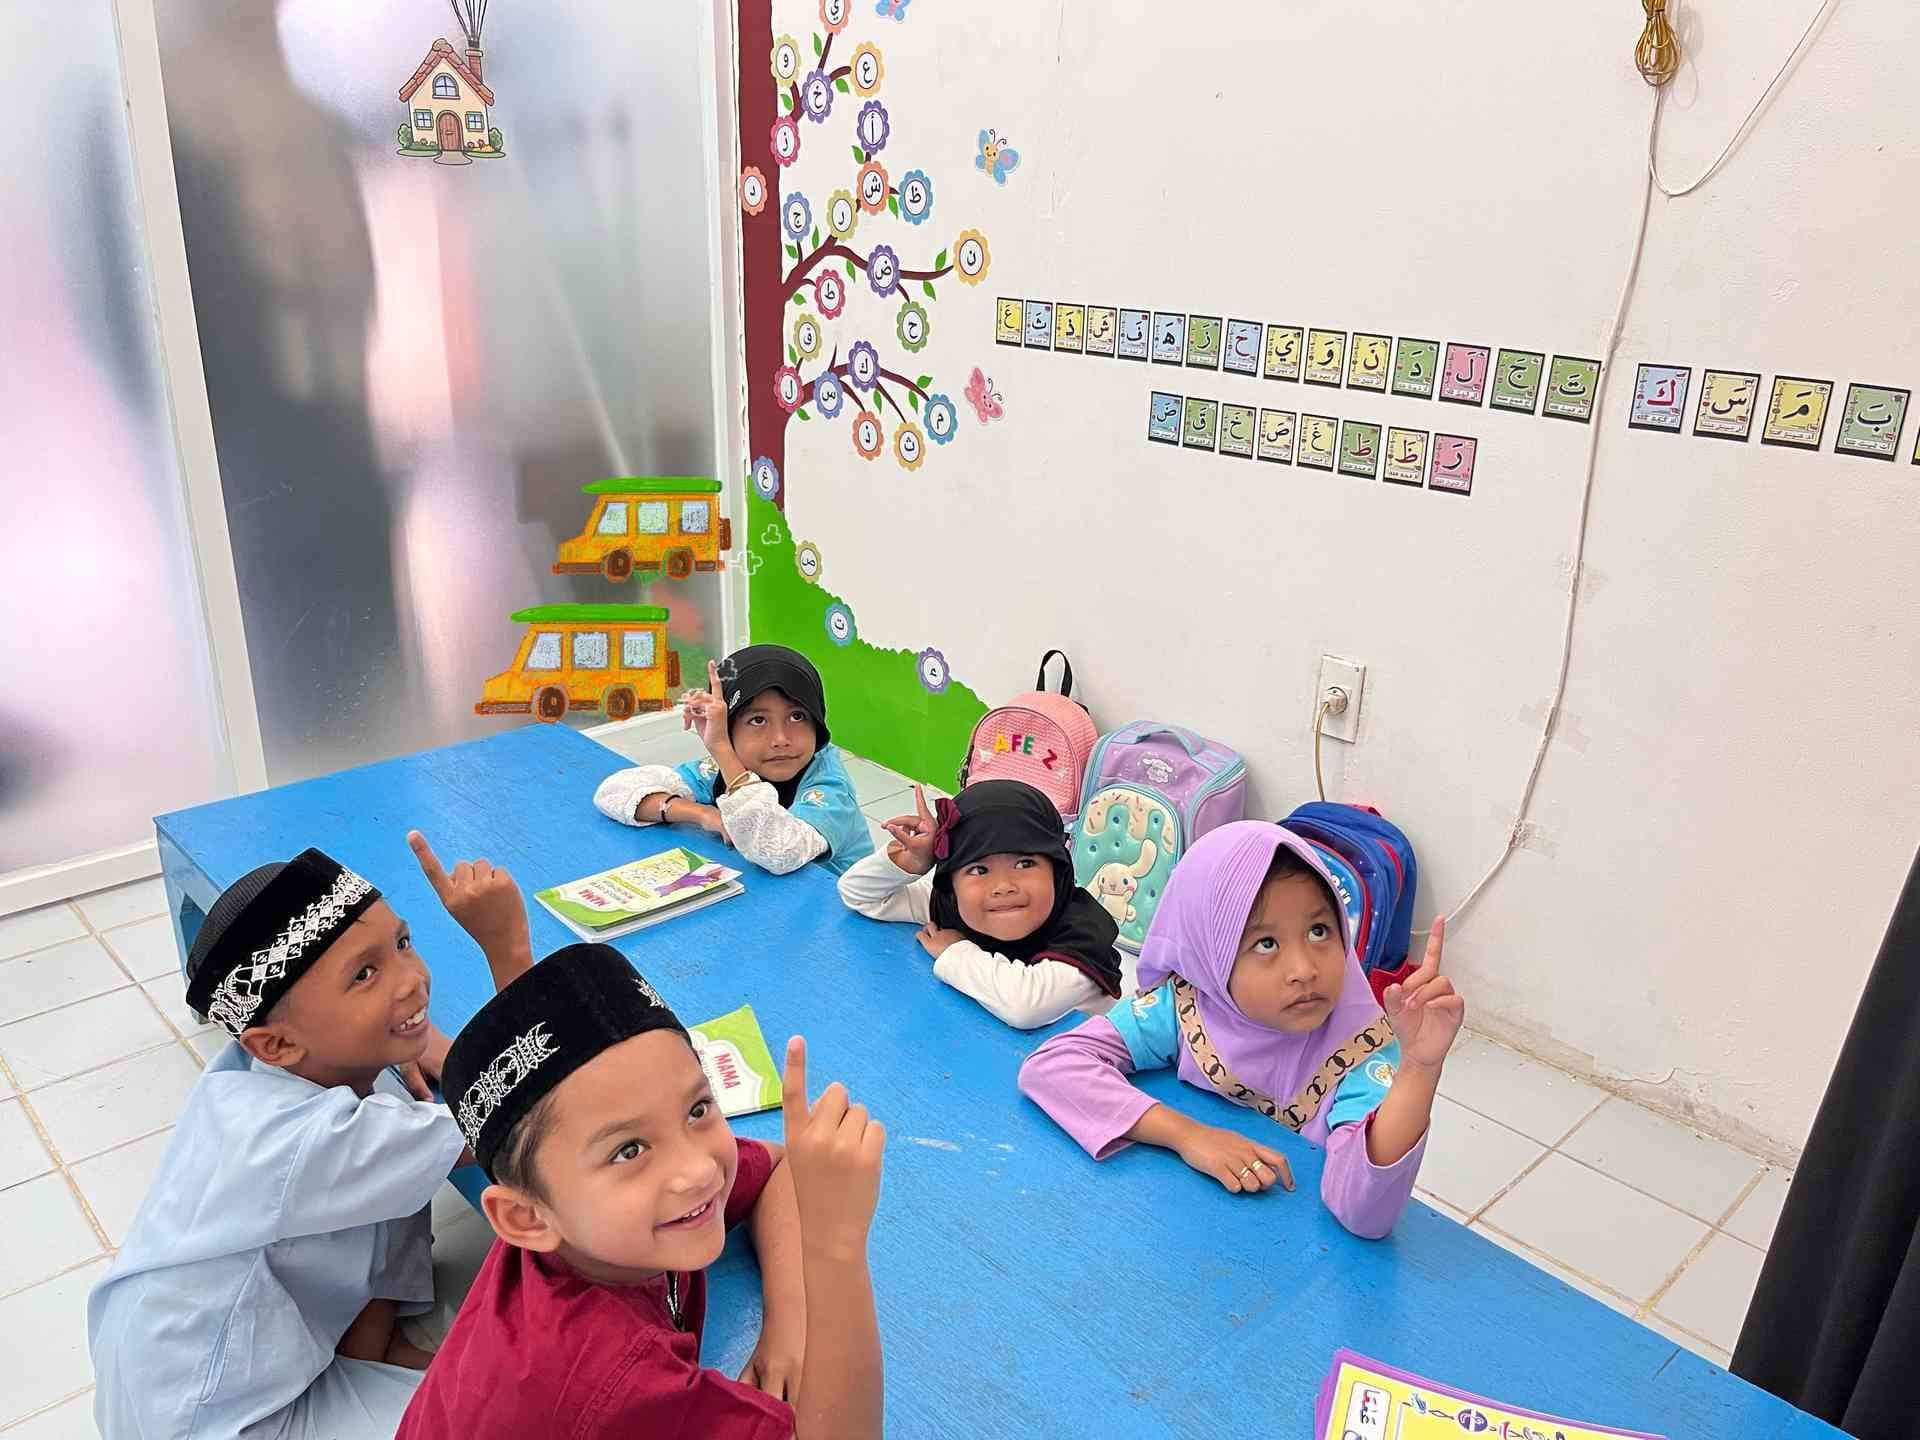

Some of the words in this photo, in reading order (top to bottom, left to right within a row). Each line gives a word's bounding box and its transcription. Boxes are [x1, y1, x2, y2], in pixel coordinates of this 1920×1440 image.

[783, 53, 789, 68] و
[862, 61, 873, 84] ع
[813, 85, 823, 109] خ
[783, 132, 789, 151] ز
[750, 183, 756, 196] د
[864, 176, 881, 199] ش
[909, 185, 922, 204] ظ
[793, 212, 802, 228] ج
[838, 210, 845, 225] ر
[967, 250, 976, 266] ن
[875, 260, 892, 279] ض
[824, 283, 836, 299] ط
[804, 327, 812, 345] ق
[908, 322, 918, 339] ح
[859, 358, 869, 376] ك
[785, 380, 793, 399] ل
[822, 390, 837, 401] س
[936, 412, 944, 429] م
[864, 425, 871, 444] ذ
[904, 436, 915, 451] ث
[762, 467, 769, 489] غ
[714, 1053, 741, 1089] MAMA
